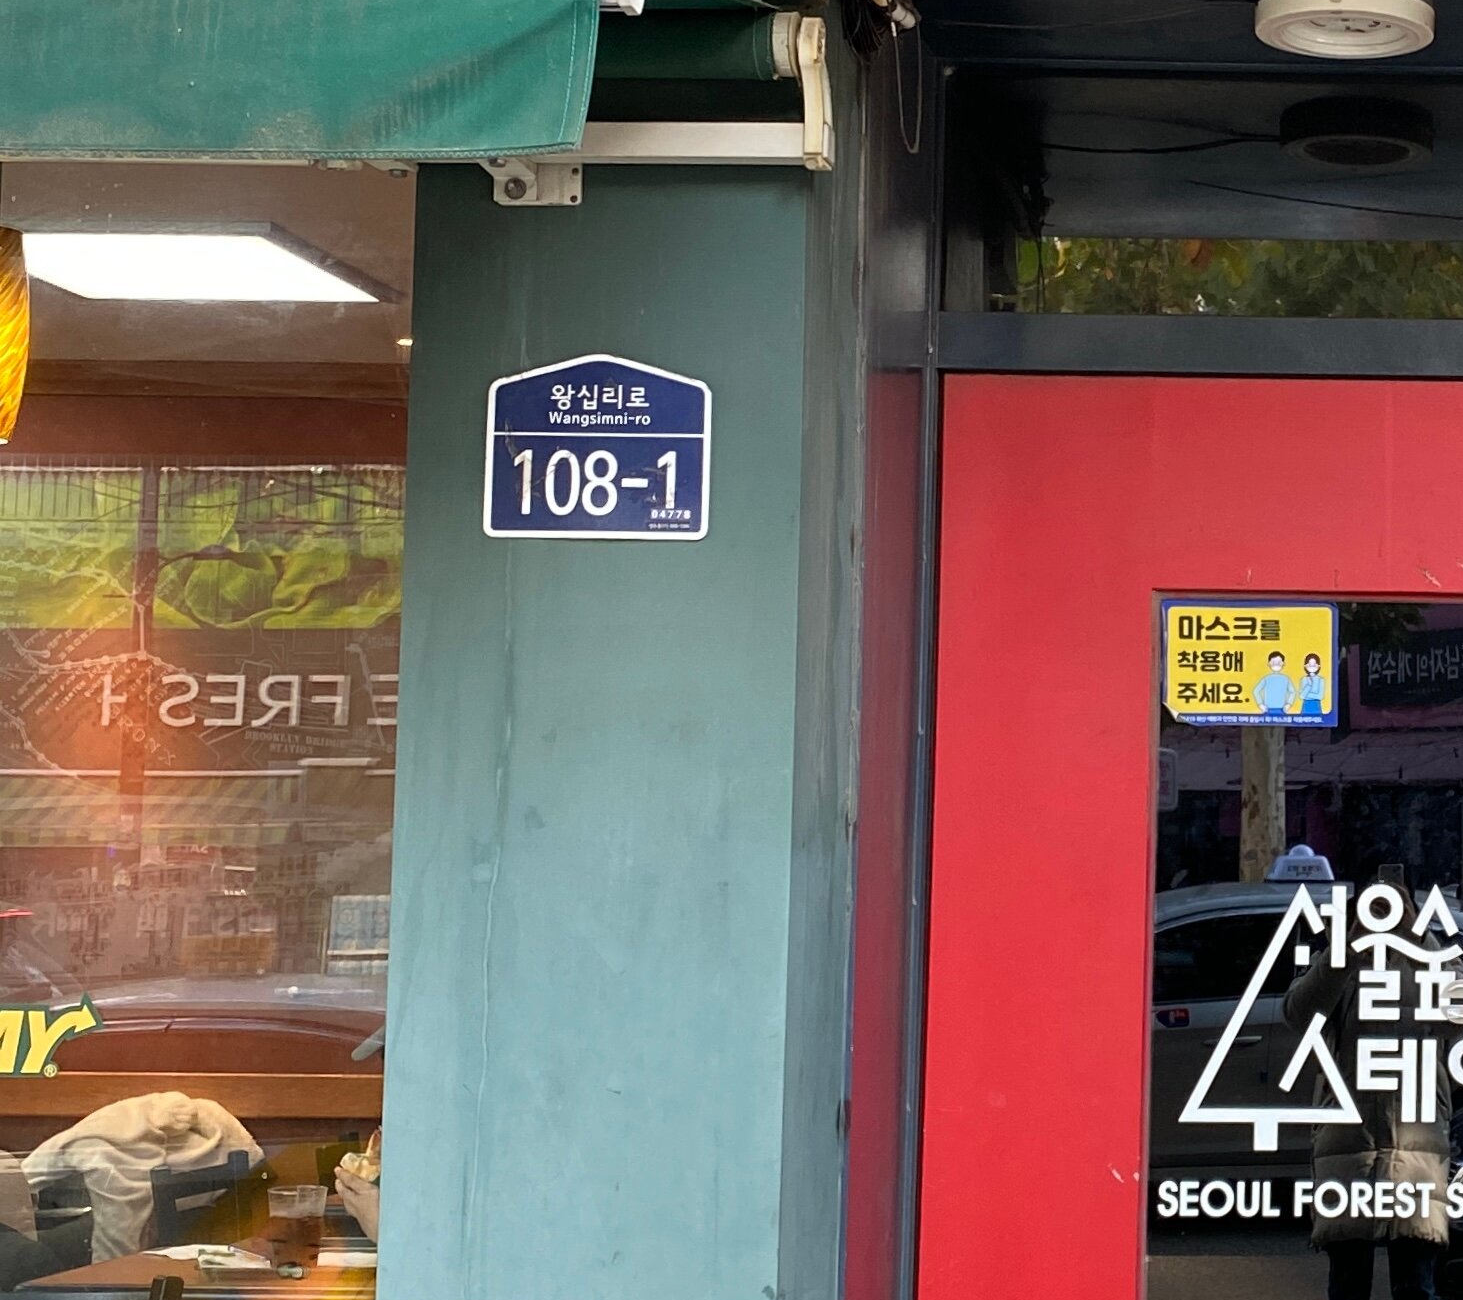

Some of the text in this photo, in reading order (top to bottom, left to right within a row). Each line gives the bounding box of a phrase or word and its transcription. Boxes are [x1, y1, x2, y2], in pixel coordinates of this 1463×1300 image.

[550, 384, 650, 410] 왕십리로
[549, 412, 651, 427] Wangsimni-ro
[513, 448, 677, 516] 108-1
[651, 510, 691, 520] 04778
[1178, 615, 1281, 641] 마스크를
[1177, 650, 1244, 673] 착용해
[1177, 683, 1250, 704] 주세요.
[1157, 1180, 1280, 1218] SEOUL
[1294, 1180, 1436, 1219] FOREST
